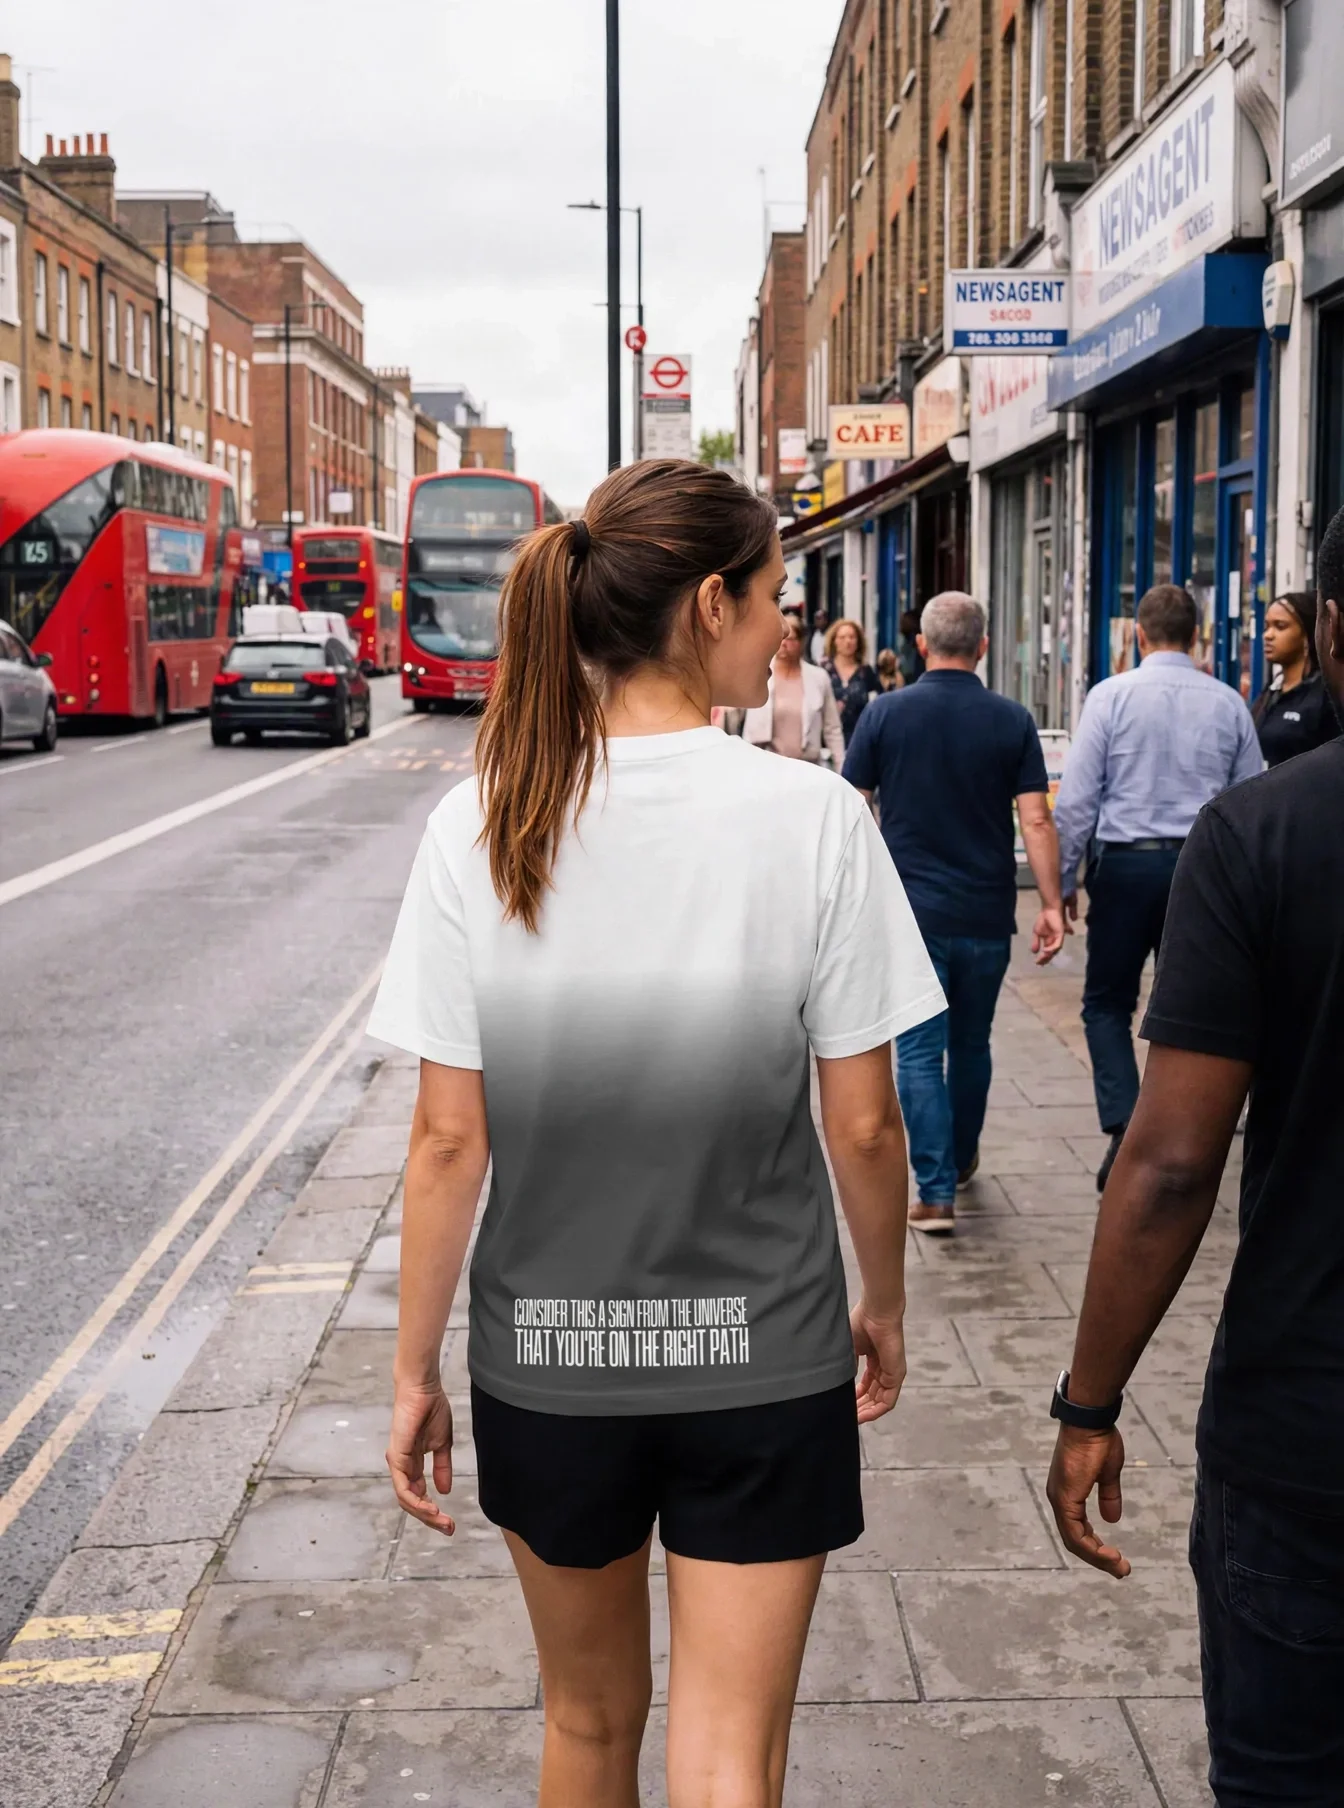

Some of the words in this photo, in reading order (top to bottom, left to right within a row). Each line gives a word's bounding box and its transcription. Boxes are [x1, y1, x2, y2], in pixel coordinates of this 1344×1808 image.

[1098, 94, 1215, 266] NEWSAGENT
[956, 282, 1065, 302] NEWSAGENT
[835, 424, 904, 443] CAFE
[515, 1299, 567, 1327] CONSIDER
[571, 1300, 595, 1327] THIS
[599, 1300, 605, 1327] A
[608, 1300, 634, 1327] SIGN
[637, 1300, 668, 1327] FROM
[671, 1299, 691, 1327] THE
[694, 1297, 747, 1326] UNIVERSE
[515, 1329, 552, 1365] THAT
[556, 1330, 605, 1367] YOU'RE
[609, 1331, 629, 1367] ON
[633, 1330, 660, 1367] THE
[664, 1329, 706, 1366] RIGHT
[710, 1328, 749, 1365] PATH
